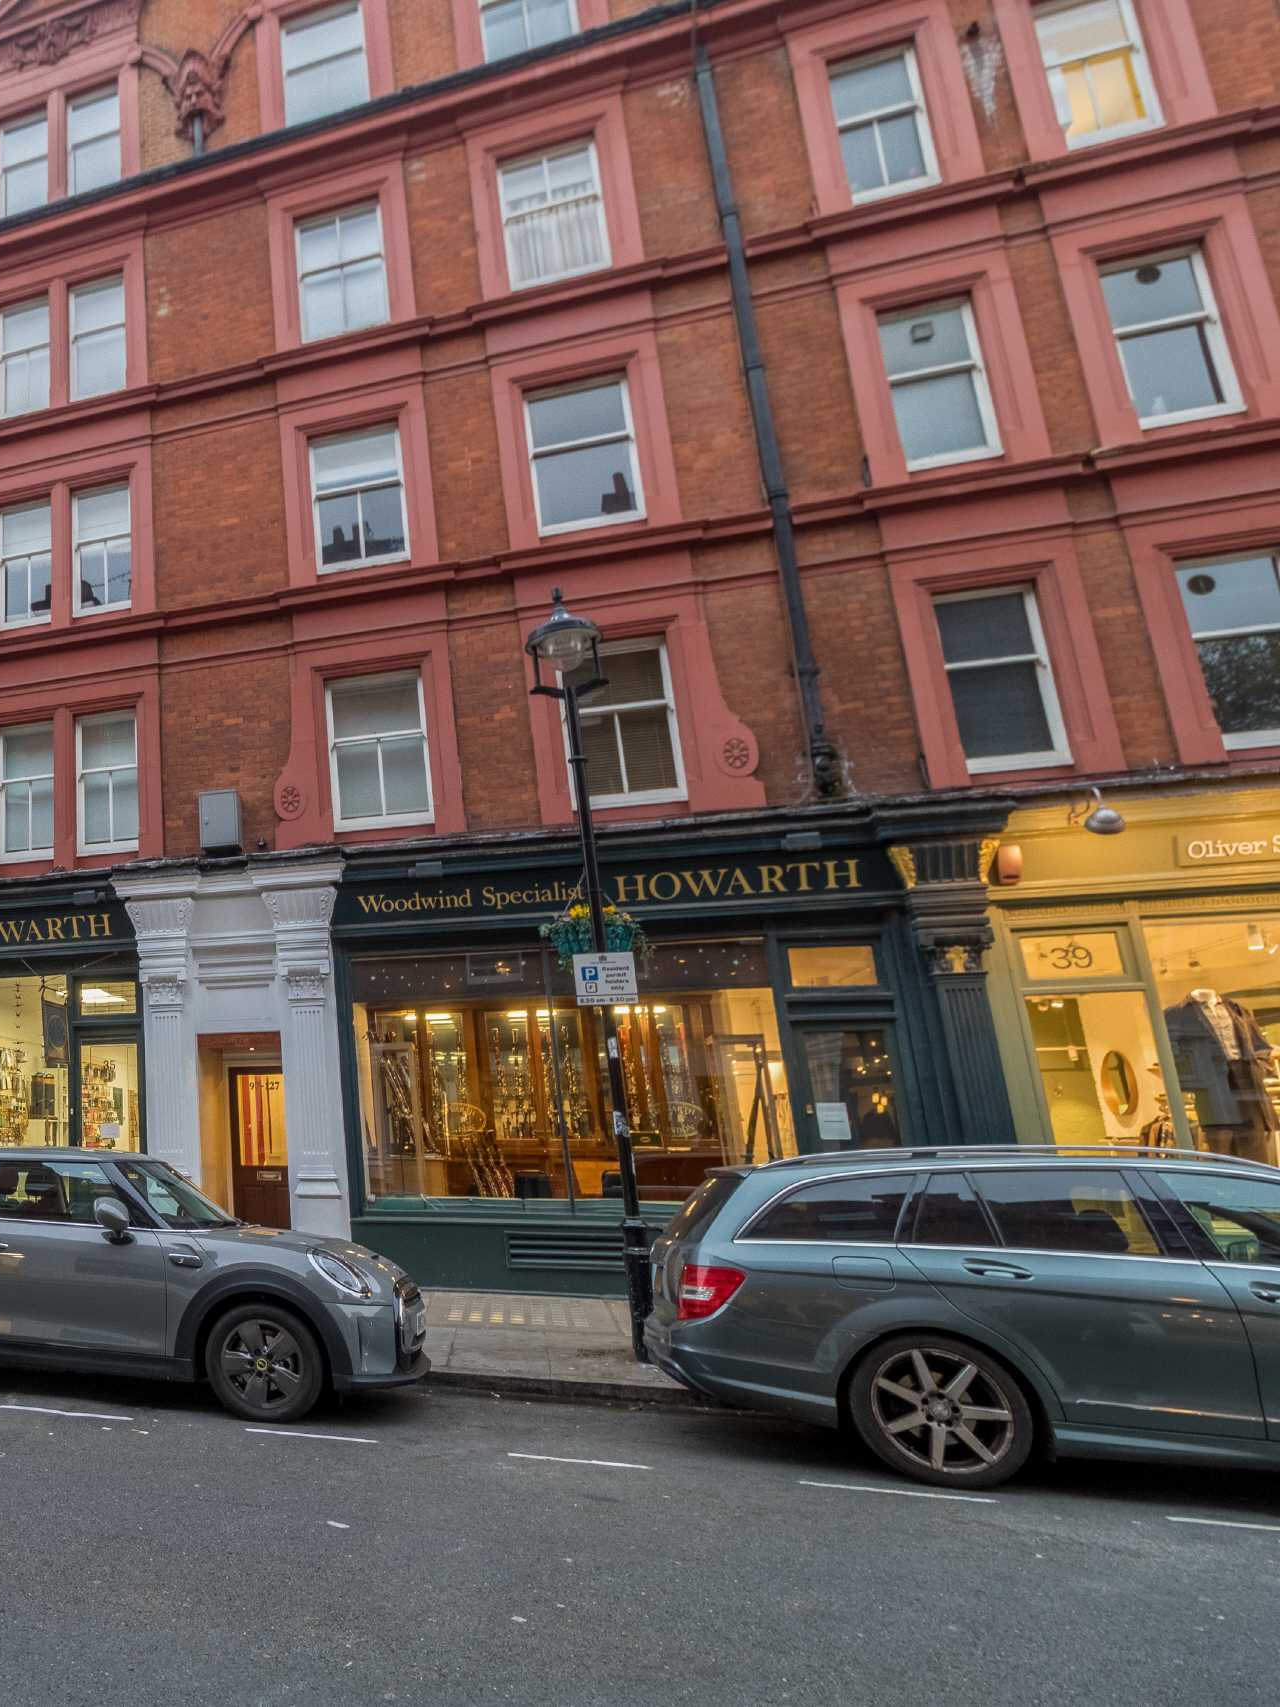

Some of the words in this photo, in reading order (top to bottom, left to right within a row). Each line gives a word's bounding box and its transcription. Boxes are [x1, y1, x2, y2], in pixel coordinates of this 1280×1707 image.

[1188, 839, 1268, 859] Oliver
[613, 859, 863, 902] HOWARTH
[357, 888, 472, 914] Woodwind
[482, 880, 586, 909] Specialist
[1050, 946, 1093, 970] 39
[585, 968, 596, 980] P
[249, 1081, 280, 1091] 9-127
